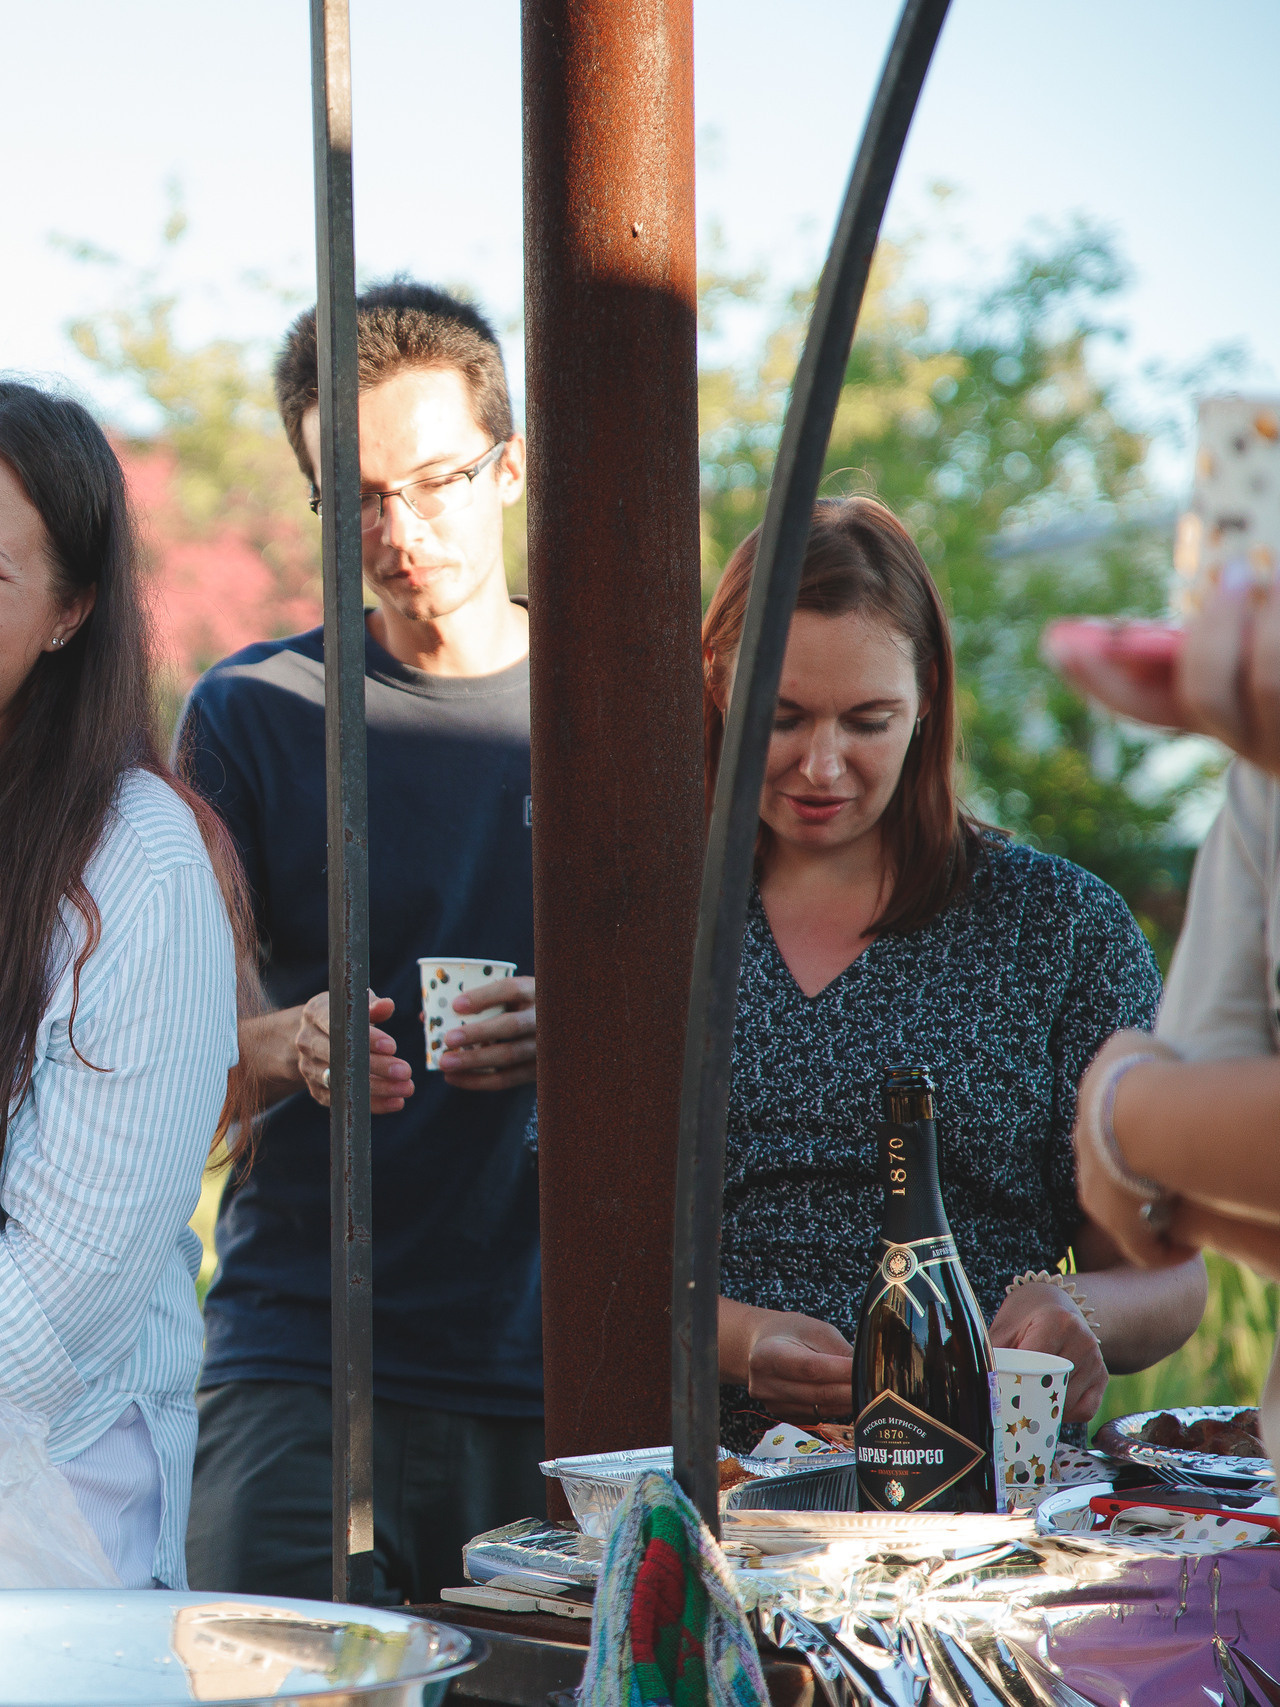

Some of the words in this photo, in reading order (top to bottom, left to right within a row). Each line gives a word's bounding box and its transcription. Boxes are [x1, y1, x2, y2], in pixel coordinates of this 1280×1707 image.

[889, 1137, 907, 1196] 1870
[863, 1417, 887, 1436] РУССКОЕ
[888, 1417, 928, 1439] ИГРИСТОЕ
[858, 1446, 944, 1466] АБРАУ-ДЮРСО
